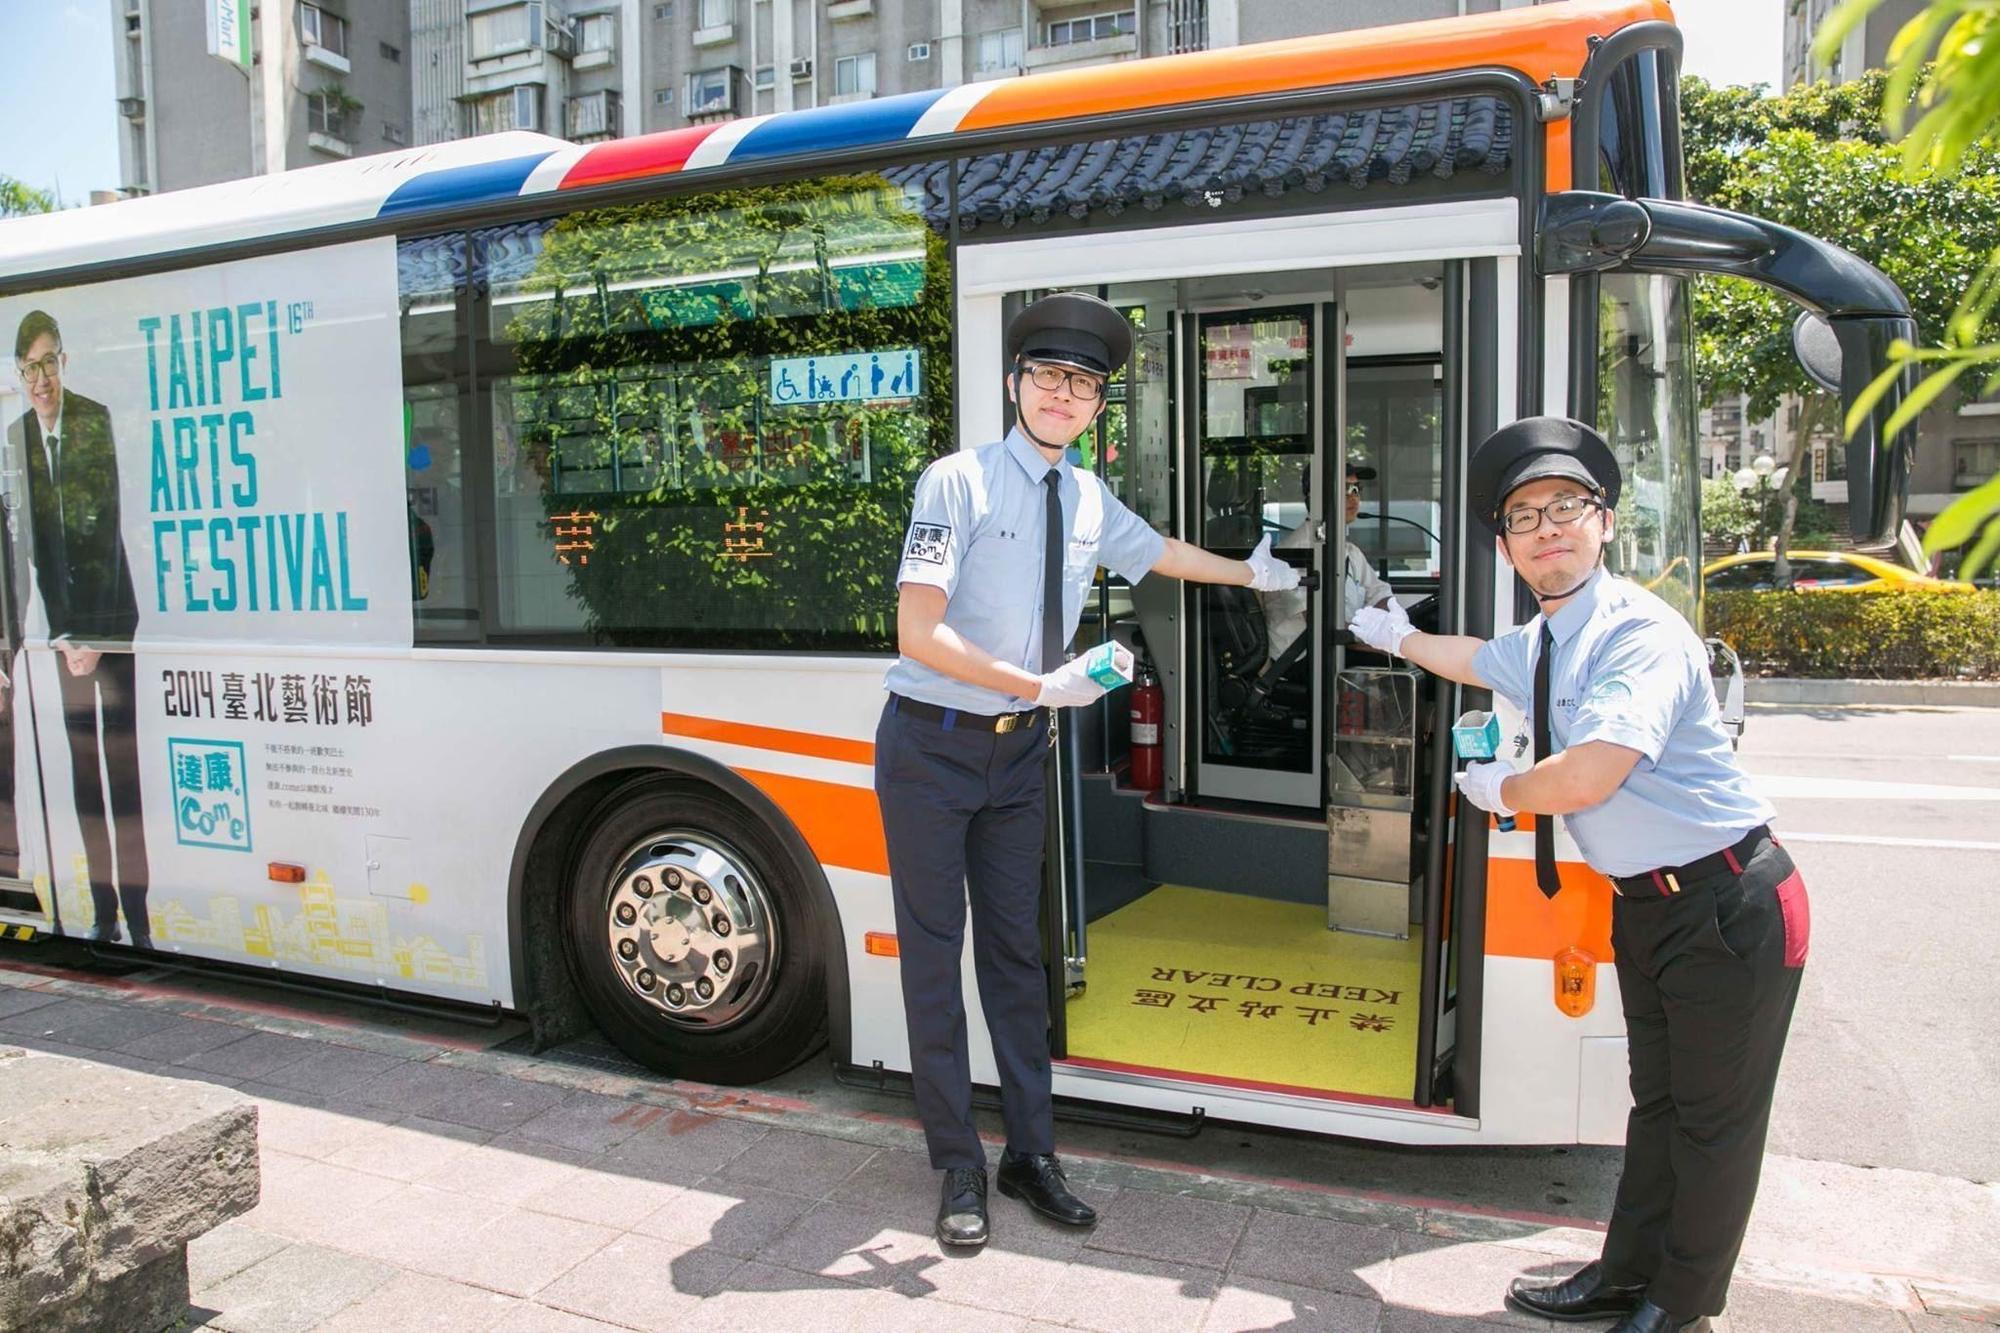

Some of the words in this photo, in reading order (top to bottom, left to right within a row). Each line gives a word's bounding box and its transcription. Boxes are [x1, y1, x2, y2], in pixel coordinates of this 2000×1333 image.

[138, 301, 282, 411] TAIPEI
[287, 301, 314, 335] 16TH
[150, 411, 258, 513] ARTS
[153, 511, 368, 613] FESTIVAL
[1131, 988, 1396, 1033] 禁止站立區
[1151, 966, 1282, 992] CLEAR
[1289, 981, 1404, 1005] KEEP
